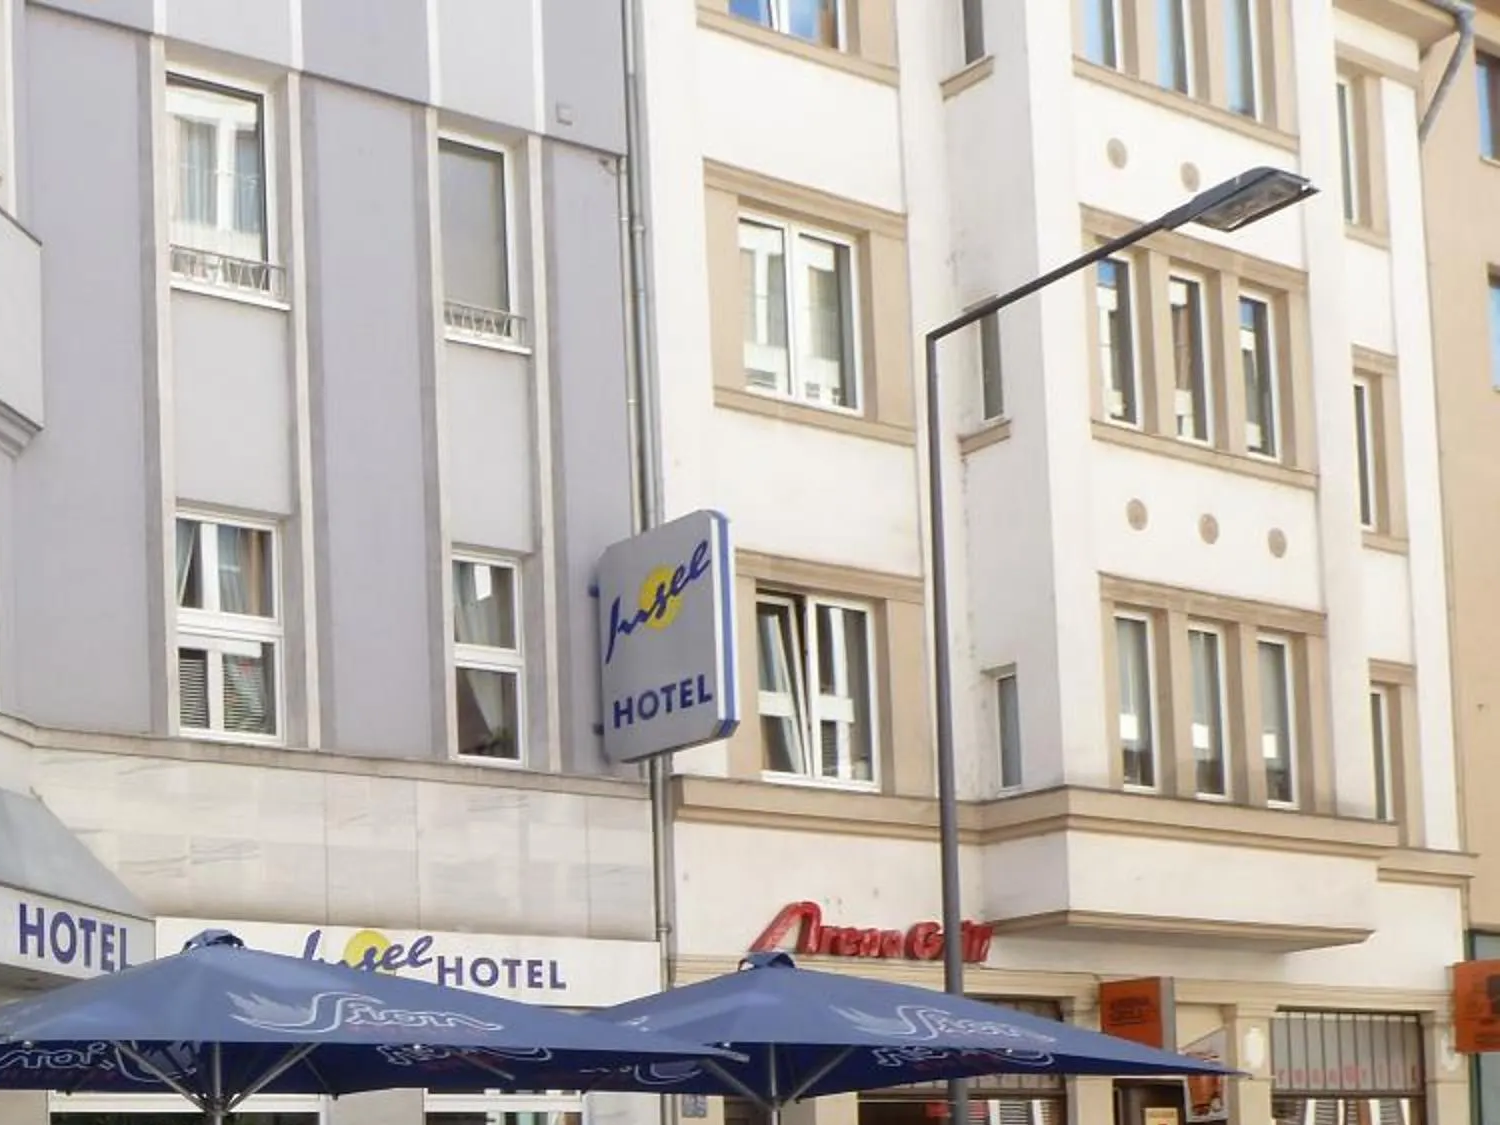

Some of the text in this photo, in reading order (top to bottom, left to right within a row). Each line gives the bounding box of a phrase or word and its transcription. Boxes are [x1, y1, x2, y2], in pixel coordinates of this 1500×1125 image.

[605, 540, 710, 665] Insel
[614, 674, 713, 729] HOTEL
[19, 902, 132, 973] HOTEL
[303, 928, 567, 990] Isel HOTEL
